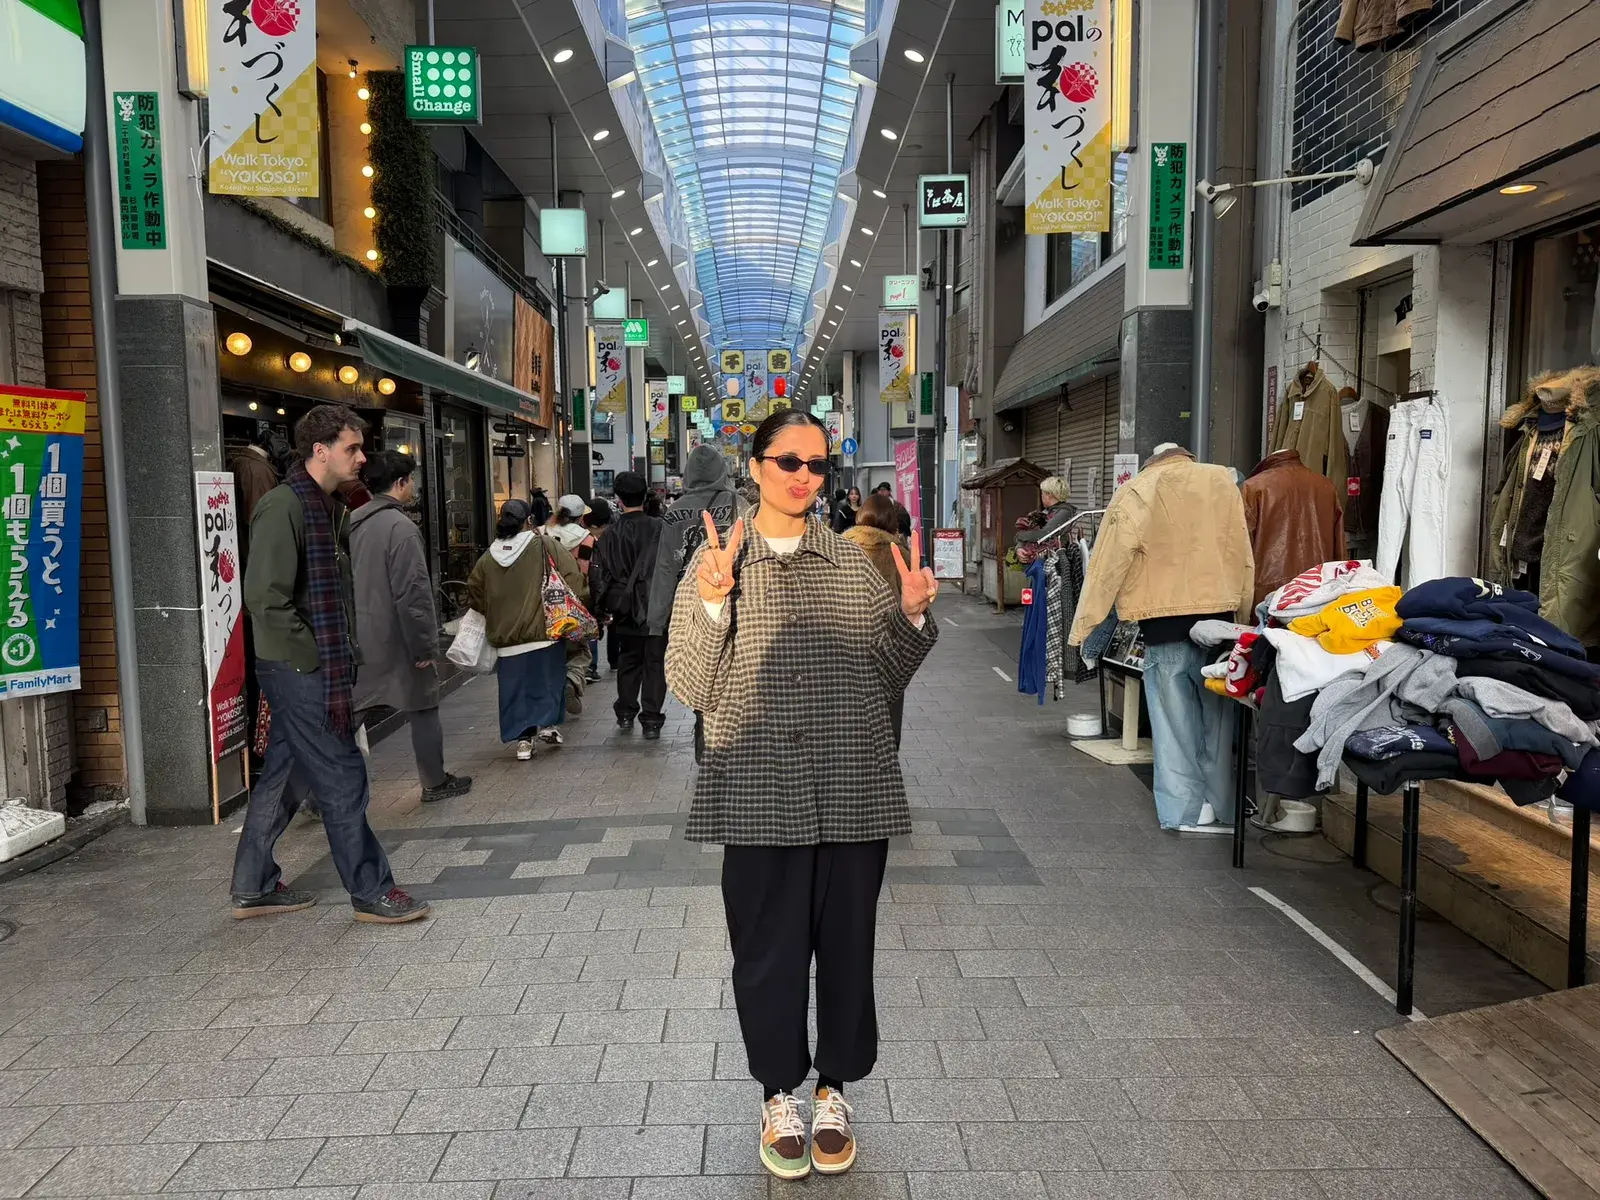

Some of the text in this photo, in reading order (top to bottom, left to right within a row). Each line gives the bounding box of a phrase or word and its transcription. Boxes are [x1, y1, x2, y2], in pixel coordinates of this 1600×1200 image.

[411, 52, 425, 98] Small
[413, 98, 471, 115] Change
[138, 94, 161, 247] 防犯カメラ作動中
[222, 154, 308, 170] Walk Tokyo.
[1034, 198, 1103, 210] Walk Tokyo.
[1168, 145, 1184, 267] 防犯カメラ作動中
[725, 353, 740, 370] 千
[13, 399, 57, 411] 無料引換券
[726, 402, 741, 418] 万
[21, 419, 48, 430] もらえる
[896, 443, 916, 467] SALE
[2, 462, 32, 628] 1個もらえる
[10, 673, 72, 691] FamilyMart
[216, 699, 229, 712] Walk
